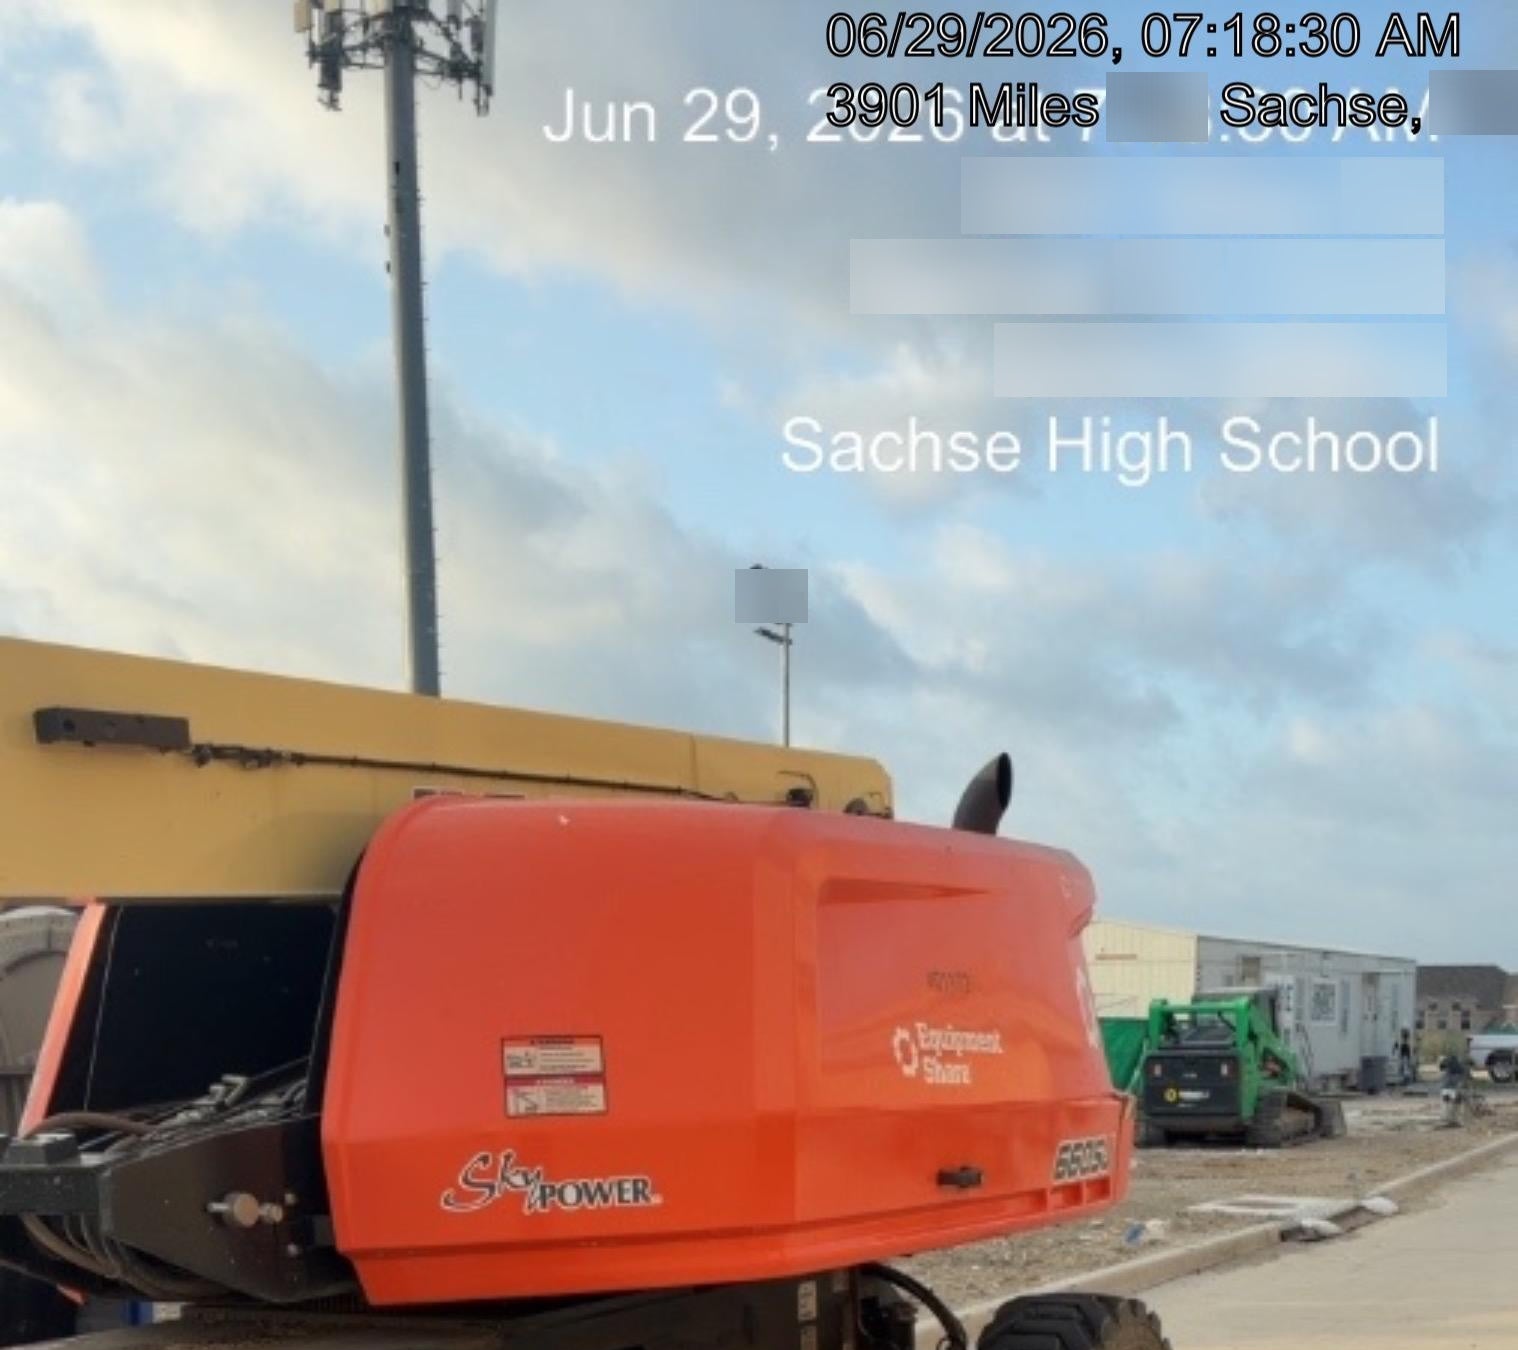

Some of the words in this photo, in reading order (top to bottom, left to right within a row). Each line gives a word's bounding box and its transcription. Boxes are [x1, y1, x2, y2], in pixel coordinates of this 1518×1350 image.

[914, 1021, 1003, 1057] Equipment
[923, 1055, 971, 1084] Share
[441, 1149, 543, 1215] Sky
[535, 1176, 656, 1212] POWER
